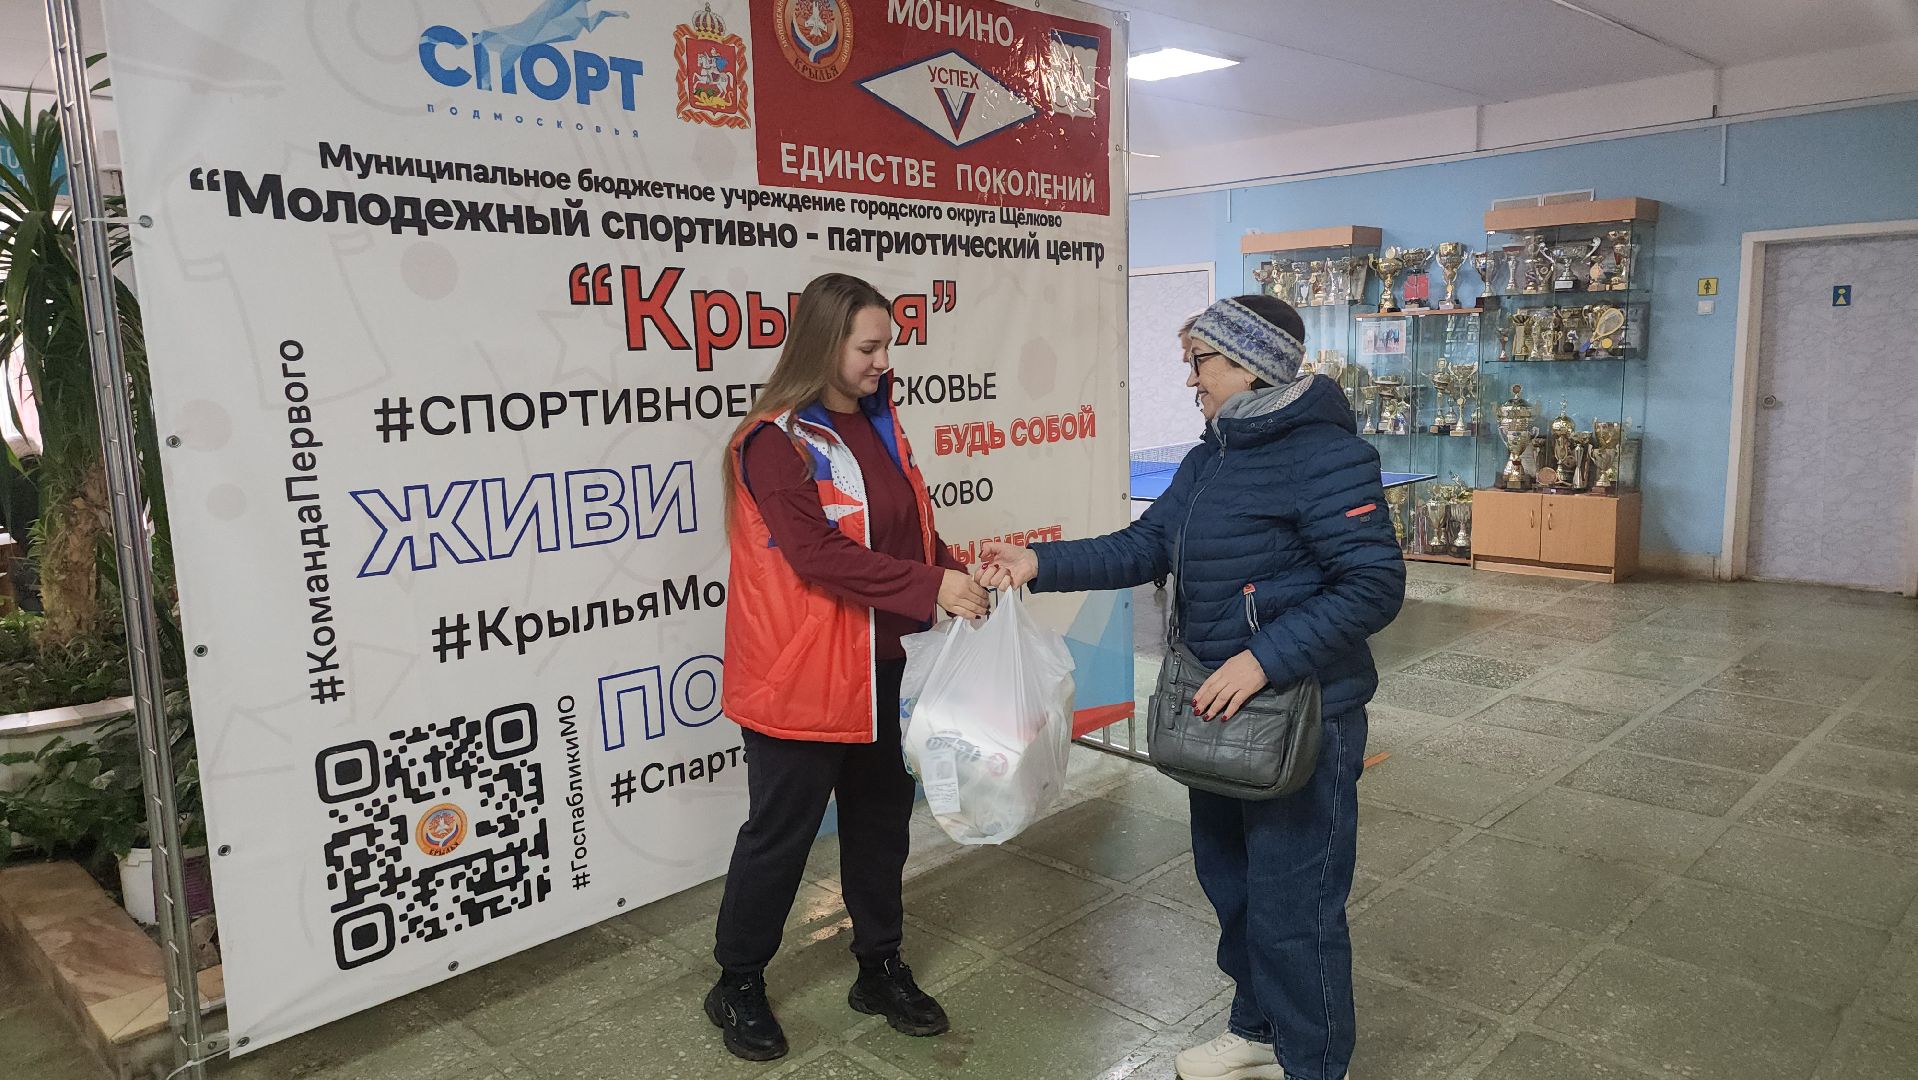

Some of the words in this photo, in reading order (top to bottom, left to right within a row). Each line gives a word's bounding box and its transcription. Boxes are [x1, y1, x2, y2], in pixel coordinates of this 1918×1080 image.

[888, 0, 1013, 46] МОНИНО
[419, 25, 643, 111] СПОРТ
[794, 58, 839, 81] КРЫЛЬЯ
[927, 65, 979, 90] УСПЕХ
[427, 104, 639, 138] ПОДМОСКОВЬЯ
[319, 141, 571, 192] Муниципальное
[577, 168, 715, 203] бюджетное
[720, 188, 846, 213] учреждение
[850, 197, 943, 222] городского
[947, 208, 996, 225] округа
[999, 206, 1062, 229] Щёлково
[780, 142, 936, 188] ЕДИНСТВЕ
[956, 164, 1096, 203] ПОКОЛЕНИЙ
[601, 210, 798, 253] спортивно
[828, 225, 1041, 262] патриотический
[1046, 240, 1105, 269] центр
[569, 262, 957, 372] “Крыя”
[934, 420, 1006, 457] БУДЬ
[1010, 404, 1096, 447] СОБОЙ
[279, 339, 345, 704] #КомандаПервого
[349, 460, 699, 579] ЖИВИ
[927, 477, 994, 508] КОВО
[432, 575, 726, 664] #КрыльяМо
[598, 654, 725, 752] ПО
[557, 694, 591, 891] #ГоспабликиМО
[610, 745, 749, 808] #Спарт
